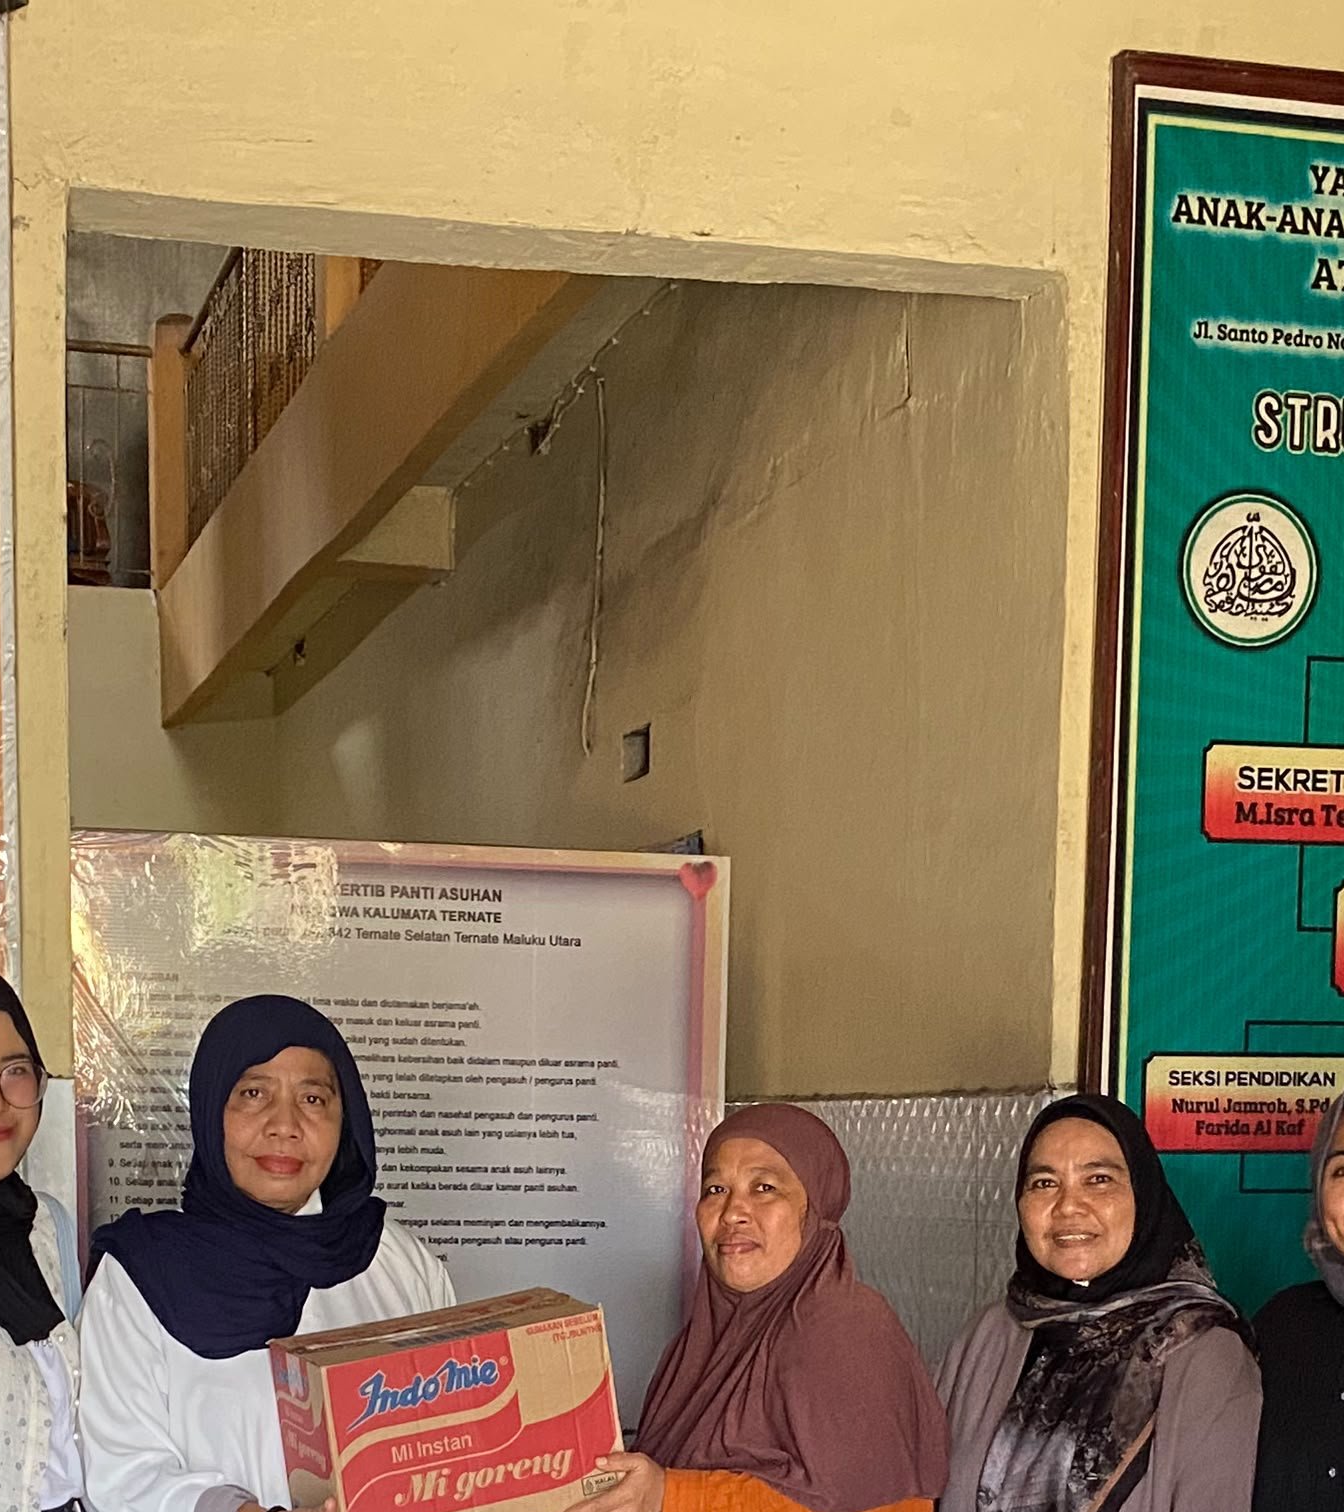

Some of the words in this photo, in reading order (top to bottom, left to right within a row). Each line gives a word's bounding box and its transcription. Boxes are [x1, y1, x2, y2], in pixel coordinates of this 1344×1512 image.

[1192, 321, 1214, 341] Jl.
[1217, 323, 1268, 345] Santo
[1271, 328, 1323, 350] Pedro
[1234, 801, 1315, 827] M.Isra
[336, 882, 385, 897] ERTIB
[390, 885, 434, 900] PANTI
[438, 887, 502, 903] ASUHAN
[363, 906, 437, 922] KALUMATA
[441, 909, 502, 924] TERNATE
[354, 927, 401, 941] Ternate
[404, 929, 451, 944] Selatan
[454, 930, 499, 946] Ternate
[502, 932, 546, 947] Maluku
[549, 933, 582, 948] Utara
[1168, 1070, 1221, 1087] SEKSI
[1224, 1071, 1336, 1087] PENDIDIKAN
[391, 1445, 413, 1464] Mi
[416, 1433, 473, 1457] Instan
[393, 1468, 447, 1507] Mi
[453, 1448, 574, 1500] goreng
